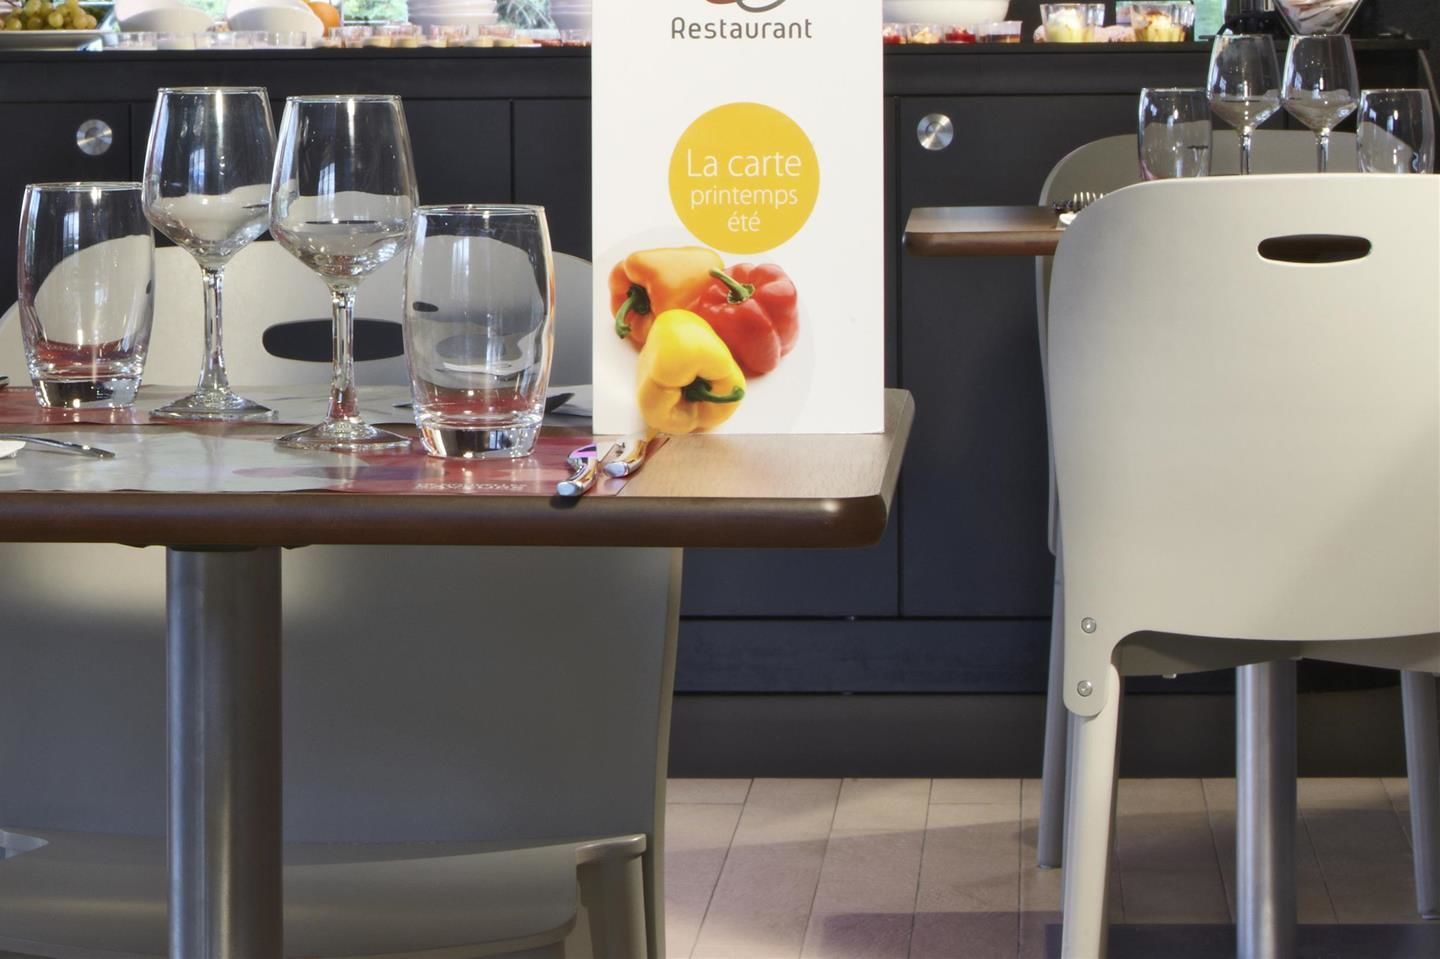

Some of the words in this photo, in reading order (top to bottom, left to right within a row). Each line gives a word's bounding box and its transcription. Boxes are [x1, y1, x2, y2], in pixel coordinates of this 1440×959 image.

[671, 16, 813, 40] Restaurant
[686, 148, 718, 177] La
[727, 150, 802, 177] carte
[690, 184, 799, 209] printemps
[727, 211, 761, 232] été
